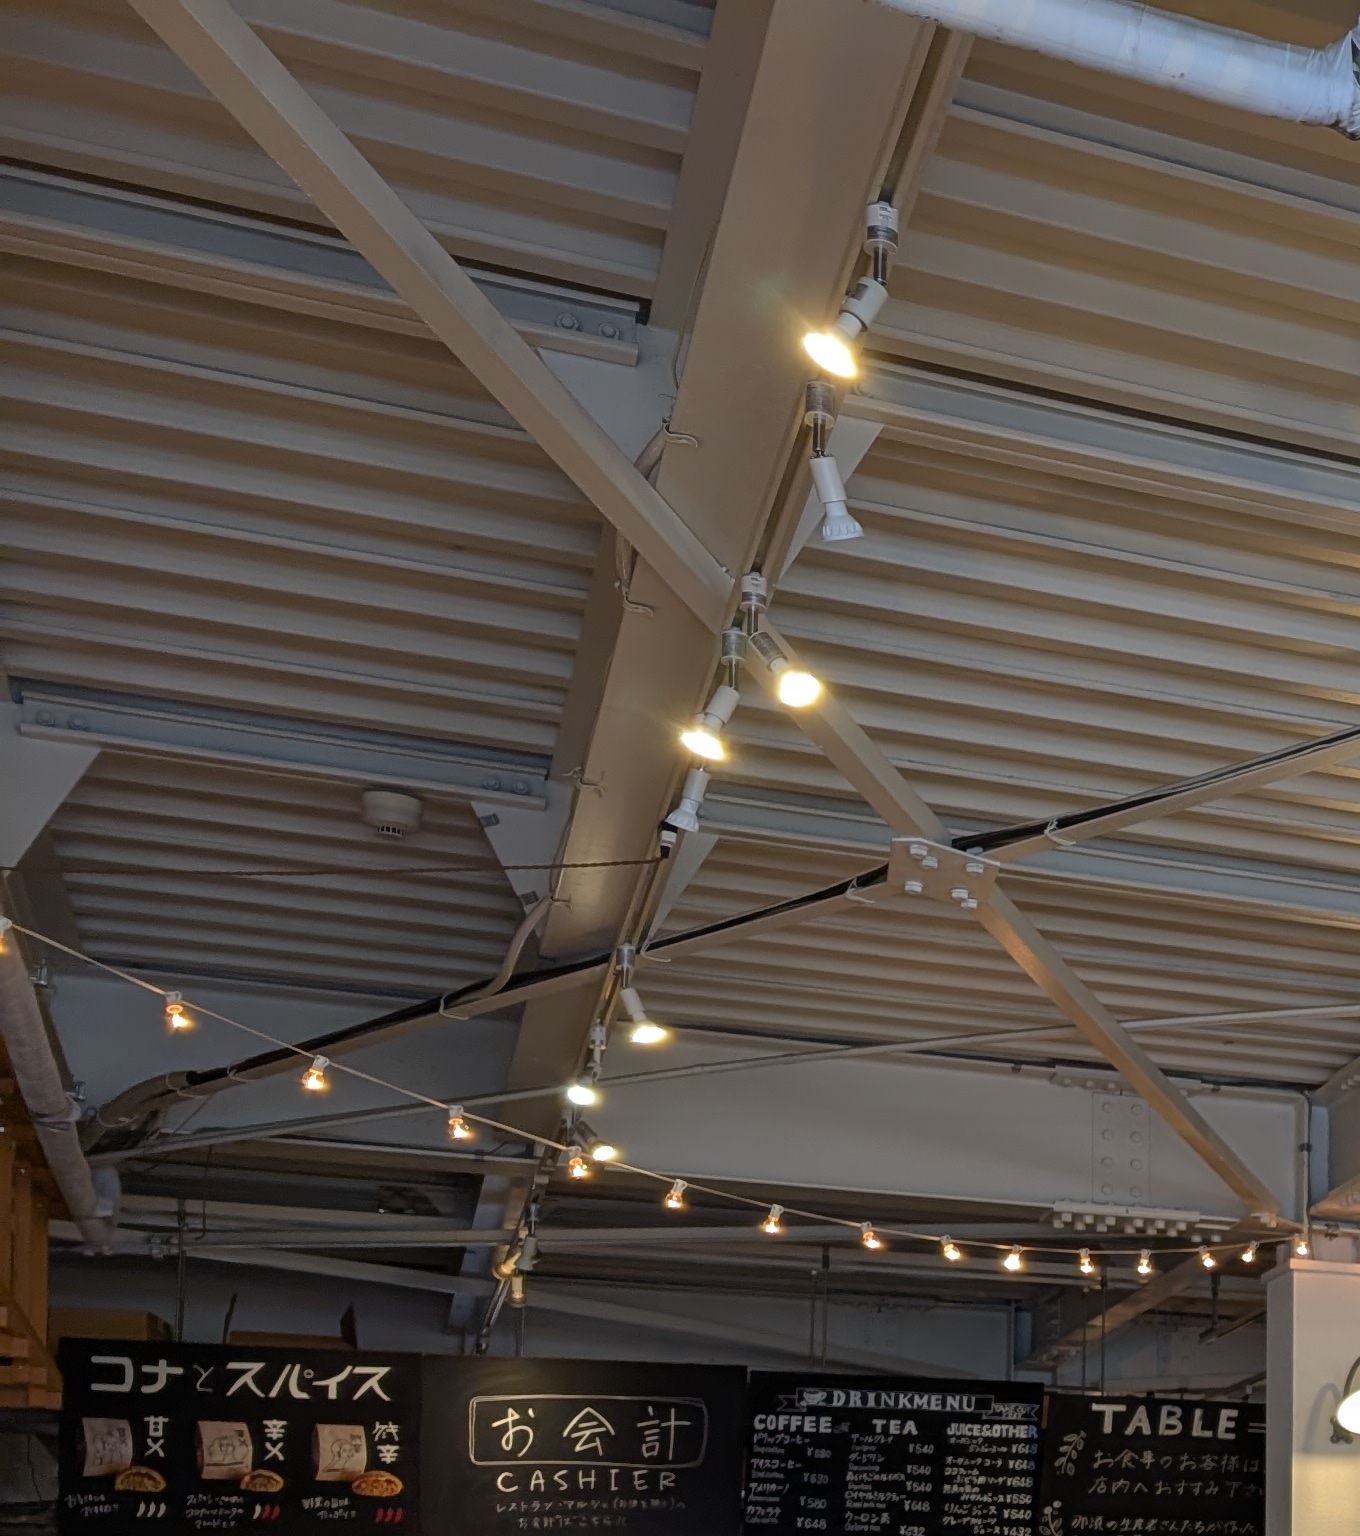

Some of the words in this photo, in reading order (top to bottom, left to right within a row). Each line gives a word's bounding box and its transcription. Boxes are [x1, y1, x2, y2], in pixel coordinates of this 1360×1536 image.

[90, 1354, 393, 1402] コナとスパイス
[491, 1405, 692, 1461] お会計
[753, 1413, 833, 1434] COFFEE
[872, 1418, 919, 1436] TEA
[1091, 1402, 1239, 1440] TABLE
[496, 1469, 676, 1492] CASHIER
